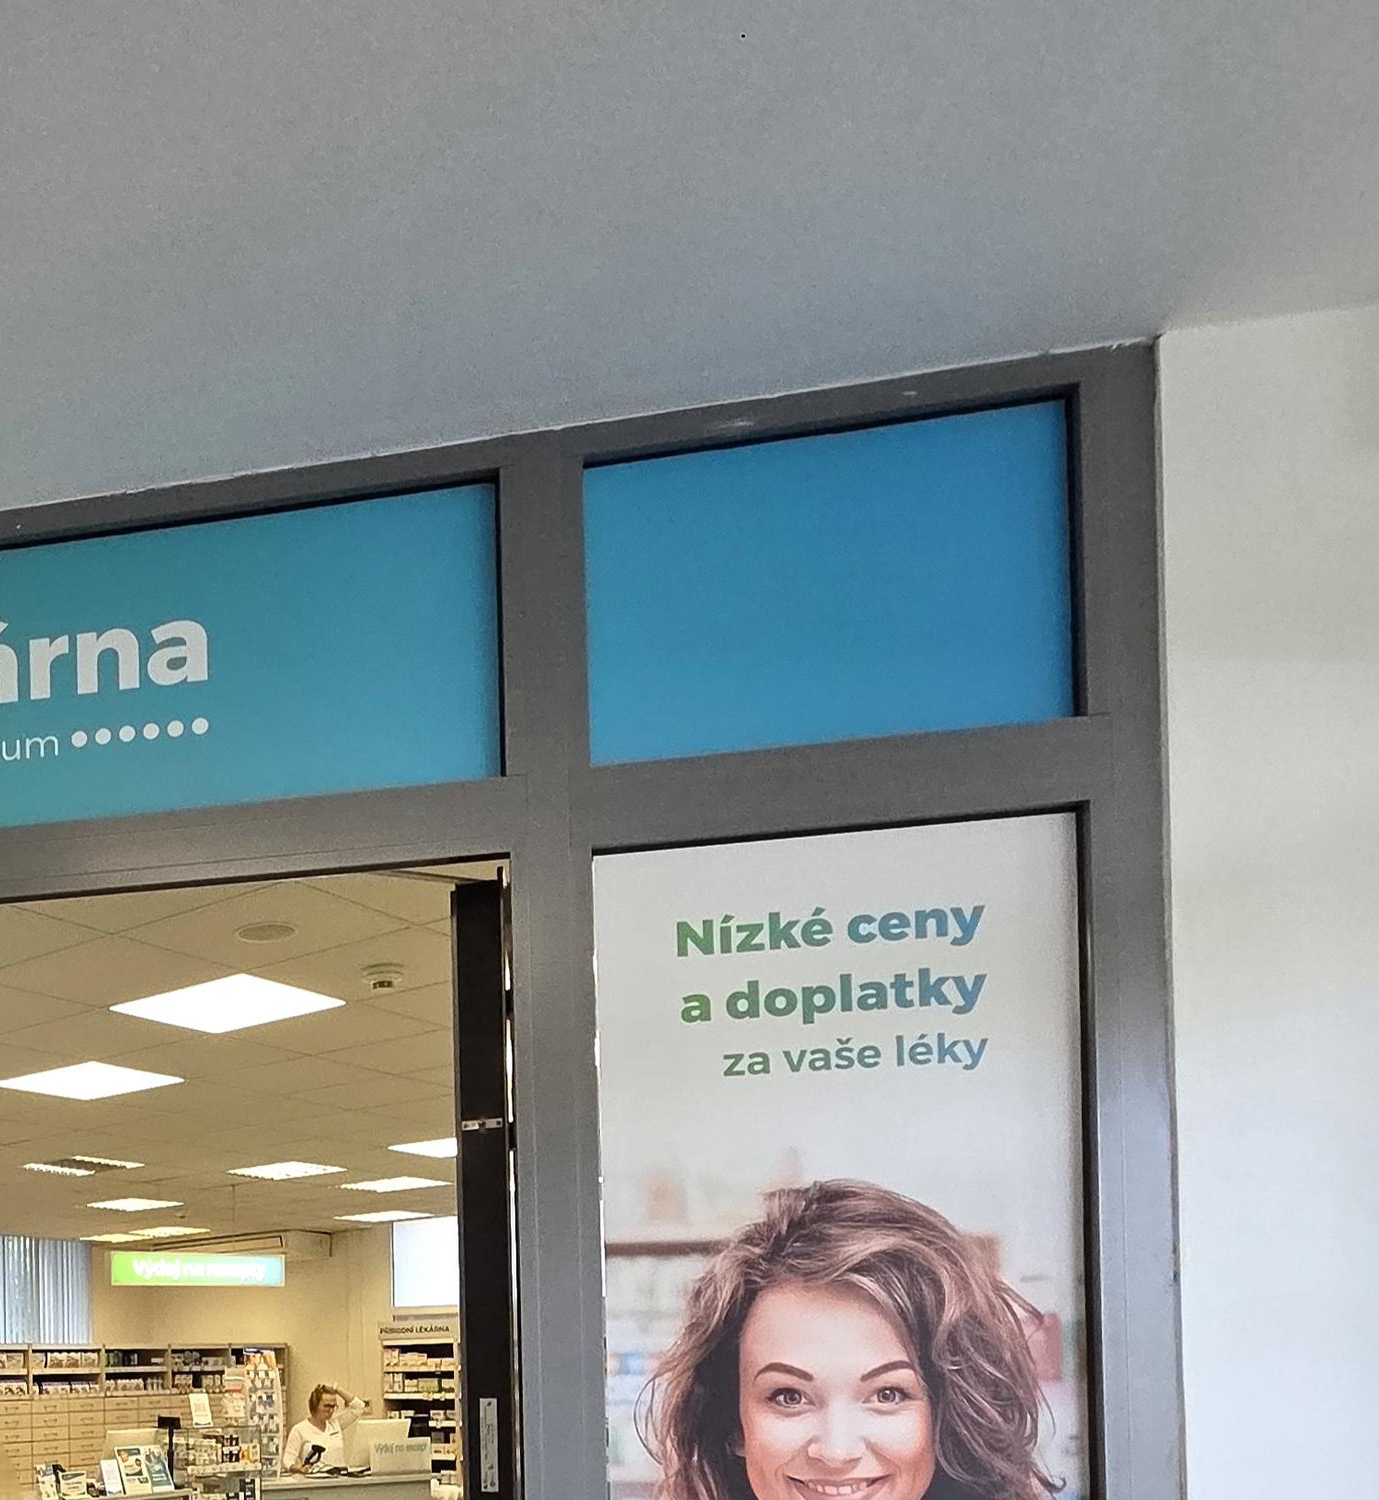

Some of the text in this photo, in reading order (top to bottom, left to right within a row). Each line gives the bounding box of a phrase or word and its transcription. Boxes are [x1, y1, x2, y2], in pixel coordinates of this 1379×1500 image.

[676, 905, 985, 957] Nízké ceny
[680, 967, 987, 1024] a doplatky
[723, 1032, 989, 1077] za vaše léky
